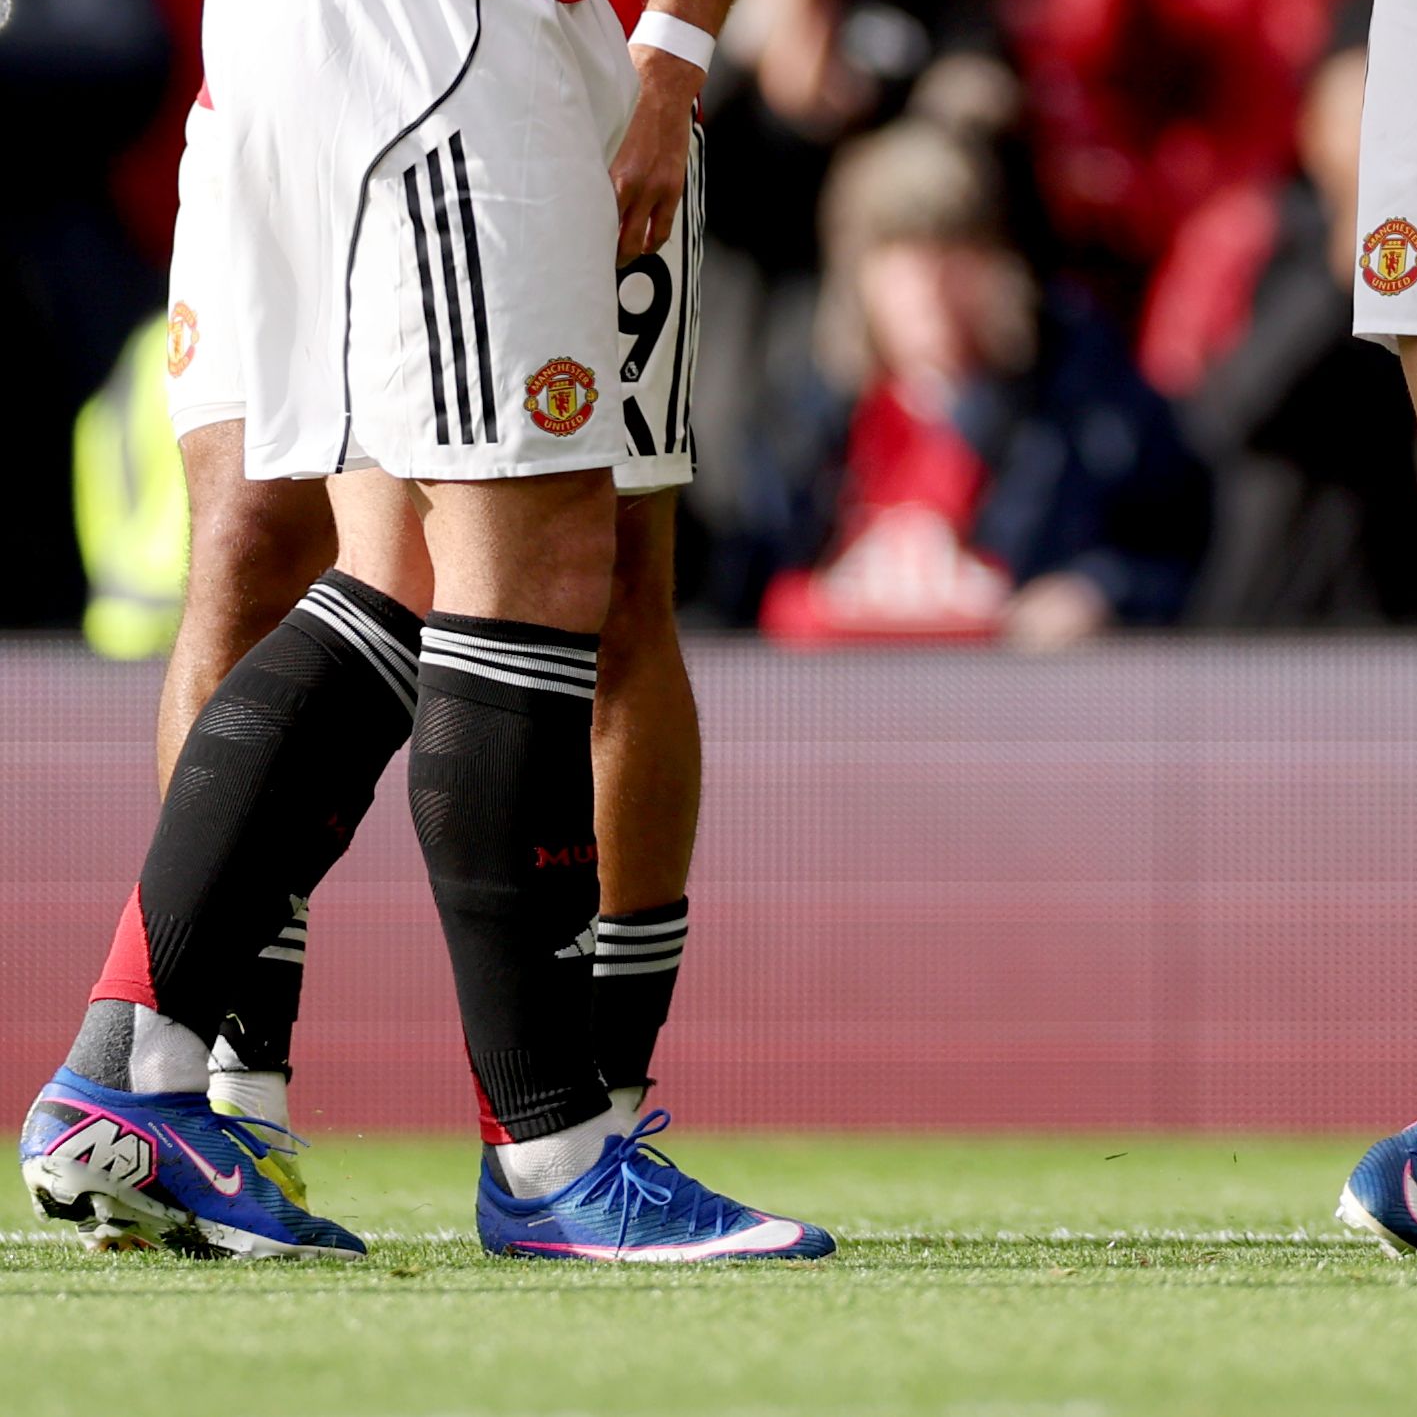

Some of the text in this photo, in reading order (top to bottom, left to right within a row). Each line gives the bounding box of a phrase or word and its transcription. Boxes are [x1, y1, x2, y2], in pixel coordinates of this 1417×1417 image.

[1372, 276, 1412, 291] UNITED
[531, 363, 589, 391] MANCHESTER
[544, 415, 584, 431] UNITED
[533, 846, 597, 869] MU
